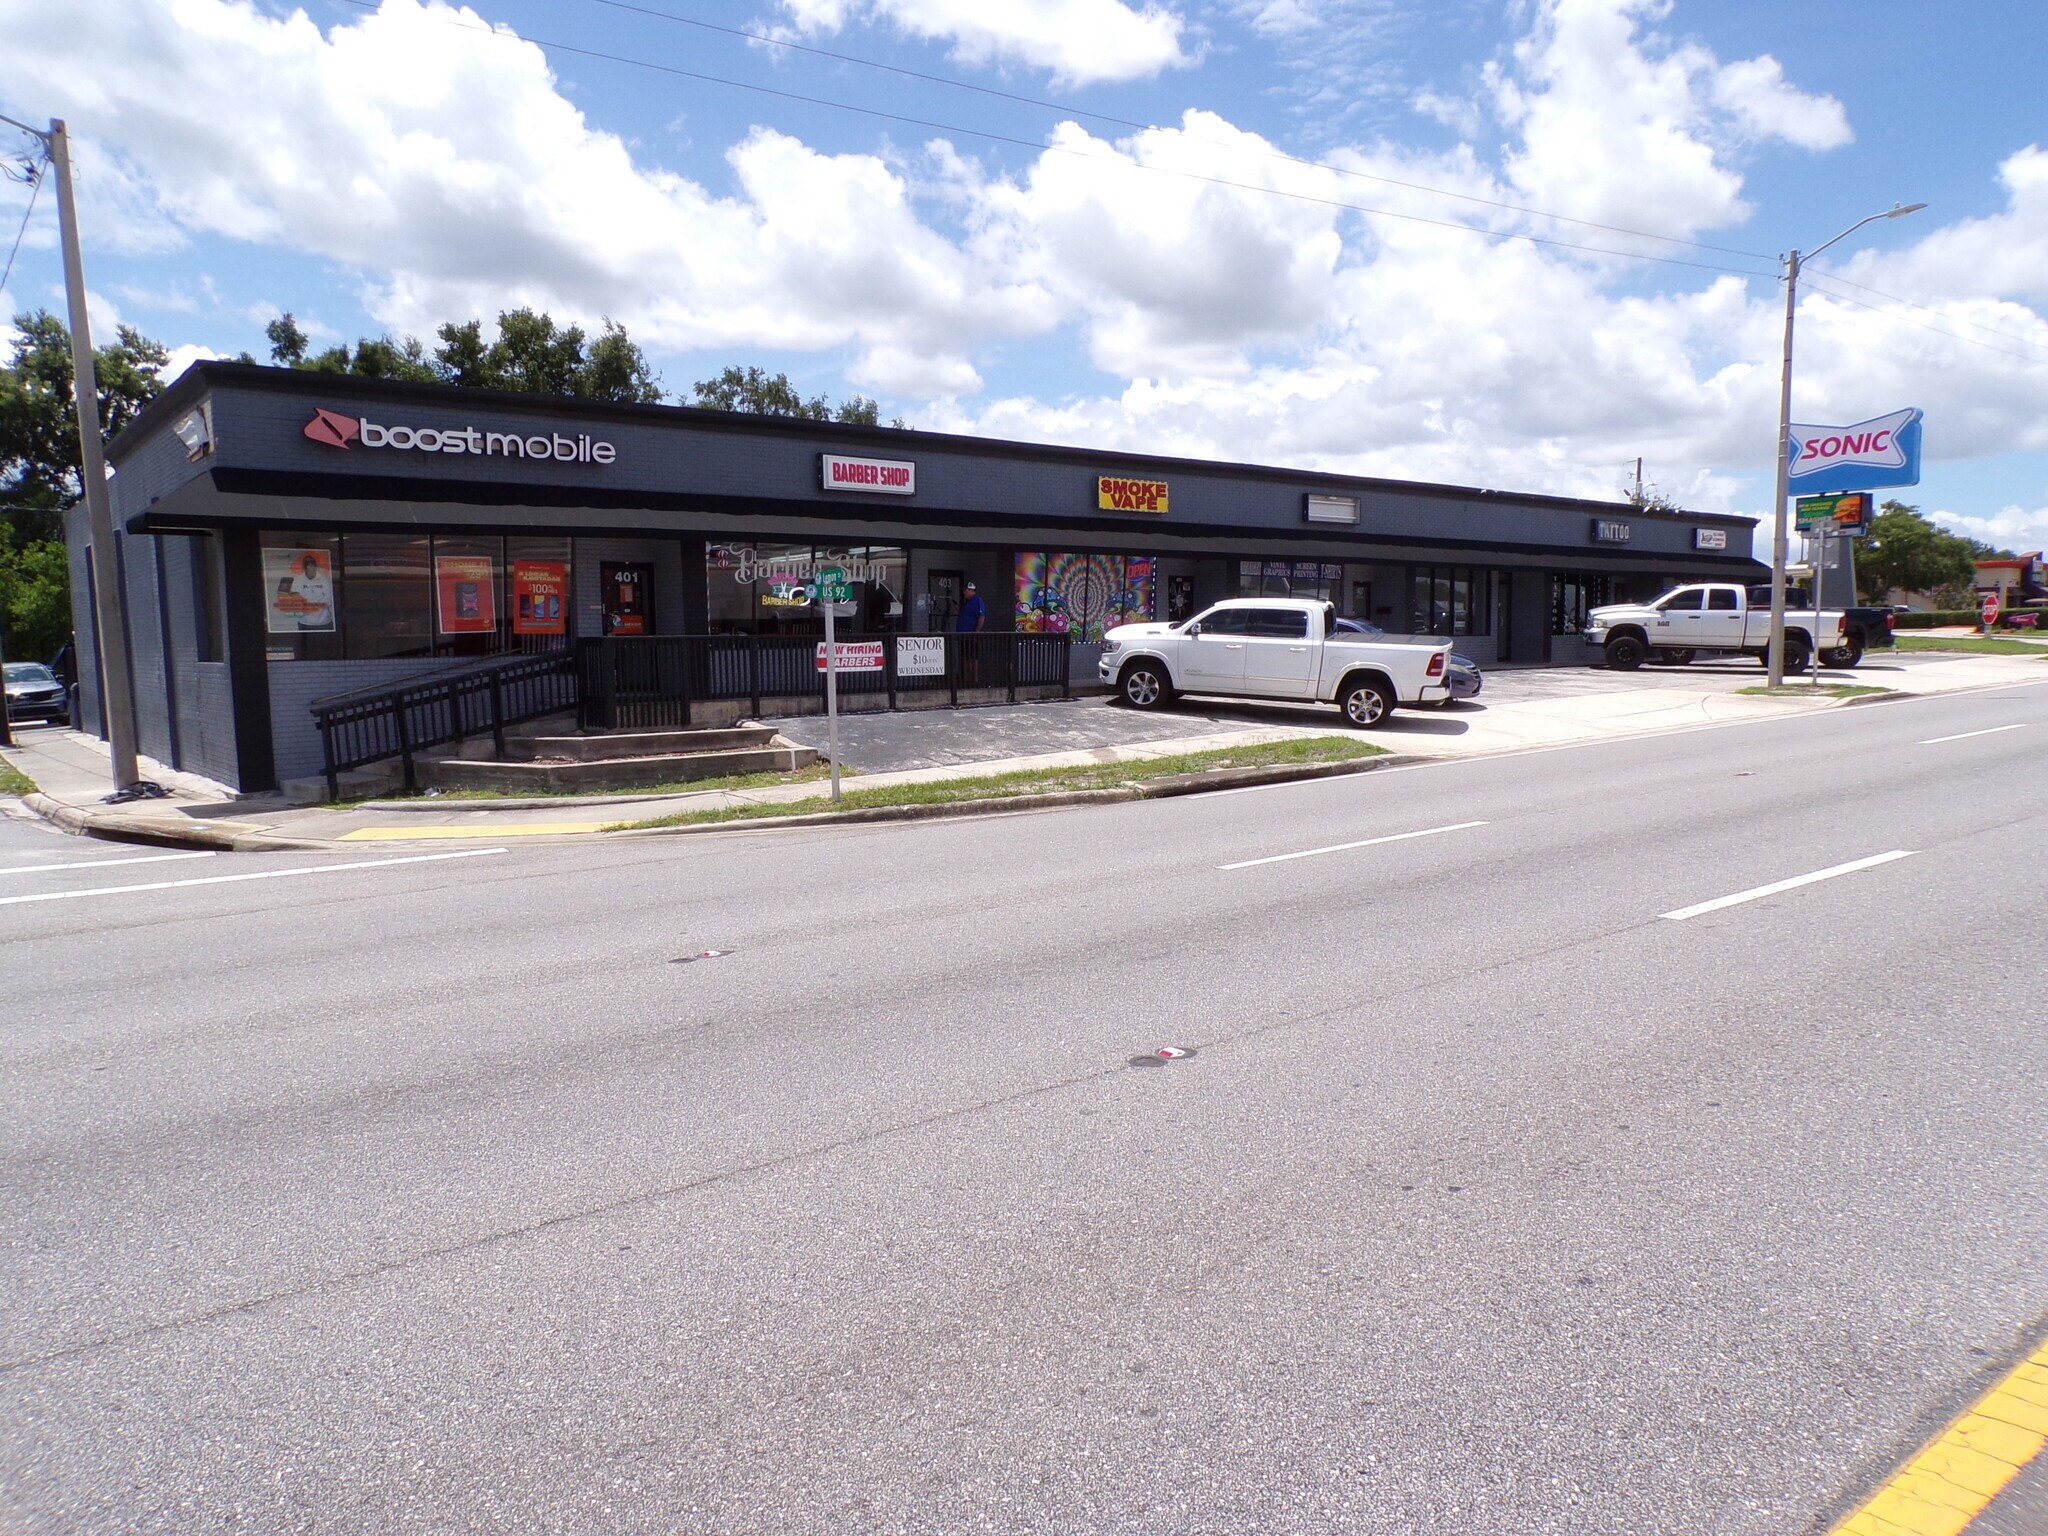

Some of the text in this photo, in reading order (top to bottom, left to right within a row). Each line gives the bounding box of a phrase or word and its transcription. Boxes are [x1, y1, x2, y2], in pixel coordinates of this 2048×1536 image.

[1800, 430, 1891, 460] SONIC
[832, 462, 910, 487] BARBER SHOP
[1100, 479, 1167, 498] SMOKE
[1110, 494, 1158, 510] VAPE
[1599, 524, 1630, 540] TATTOO
[1127, 562, 1150, 578] OPEN
[1296, 562, 1317, 570] SCREEN
[614, 571, 638, 583] 401
[822, 572, 837, 584] Lemon
[1263, 568, 1291, 577] GRAPHICS
[1293, 570, 1319, 578] PRINTING
[939, 577, 952, 588] 403
[822, 586, 833, 597] US
[835, 586, 846, 597] 92
[762, 595, 788, 606] BARBER
[788, 596, 805, 606] SHOP
[1983, 604, 1998, 616] STOP
[819, 644, 882, 655] NW HIRING
[898, 639, 943, 651] SENIOR
[834, 656, 876, 667] ARBERS
[912, 654, 927, 665] $10
[899, 666, 944, 675] WEDNESDAY
